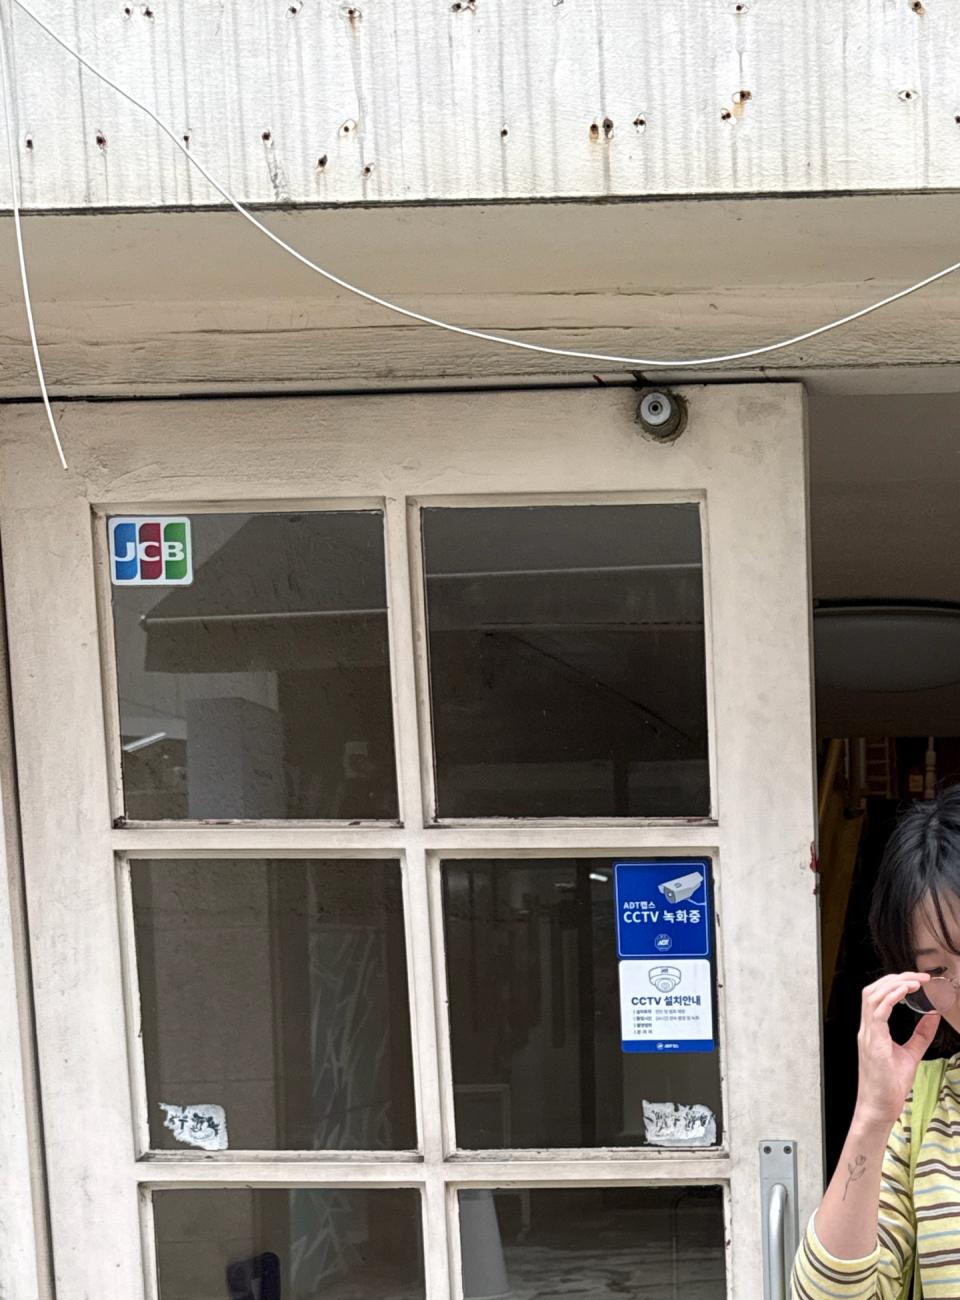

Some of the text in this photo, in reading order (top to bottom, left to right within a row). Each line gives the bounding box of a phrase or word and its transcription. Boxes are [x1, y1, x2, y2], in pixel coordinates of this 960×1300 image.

[114, 541, 185, 562] JCB
[623, 909, 701, 924] CCTV 녹화중
[631, 995, 702, 1007] CCTV 설치안내
